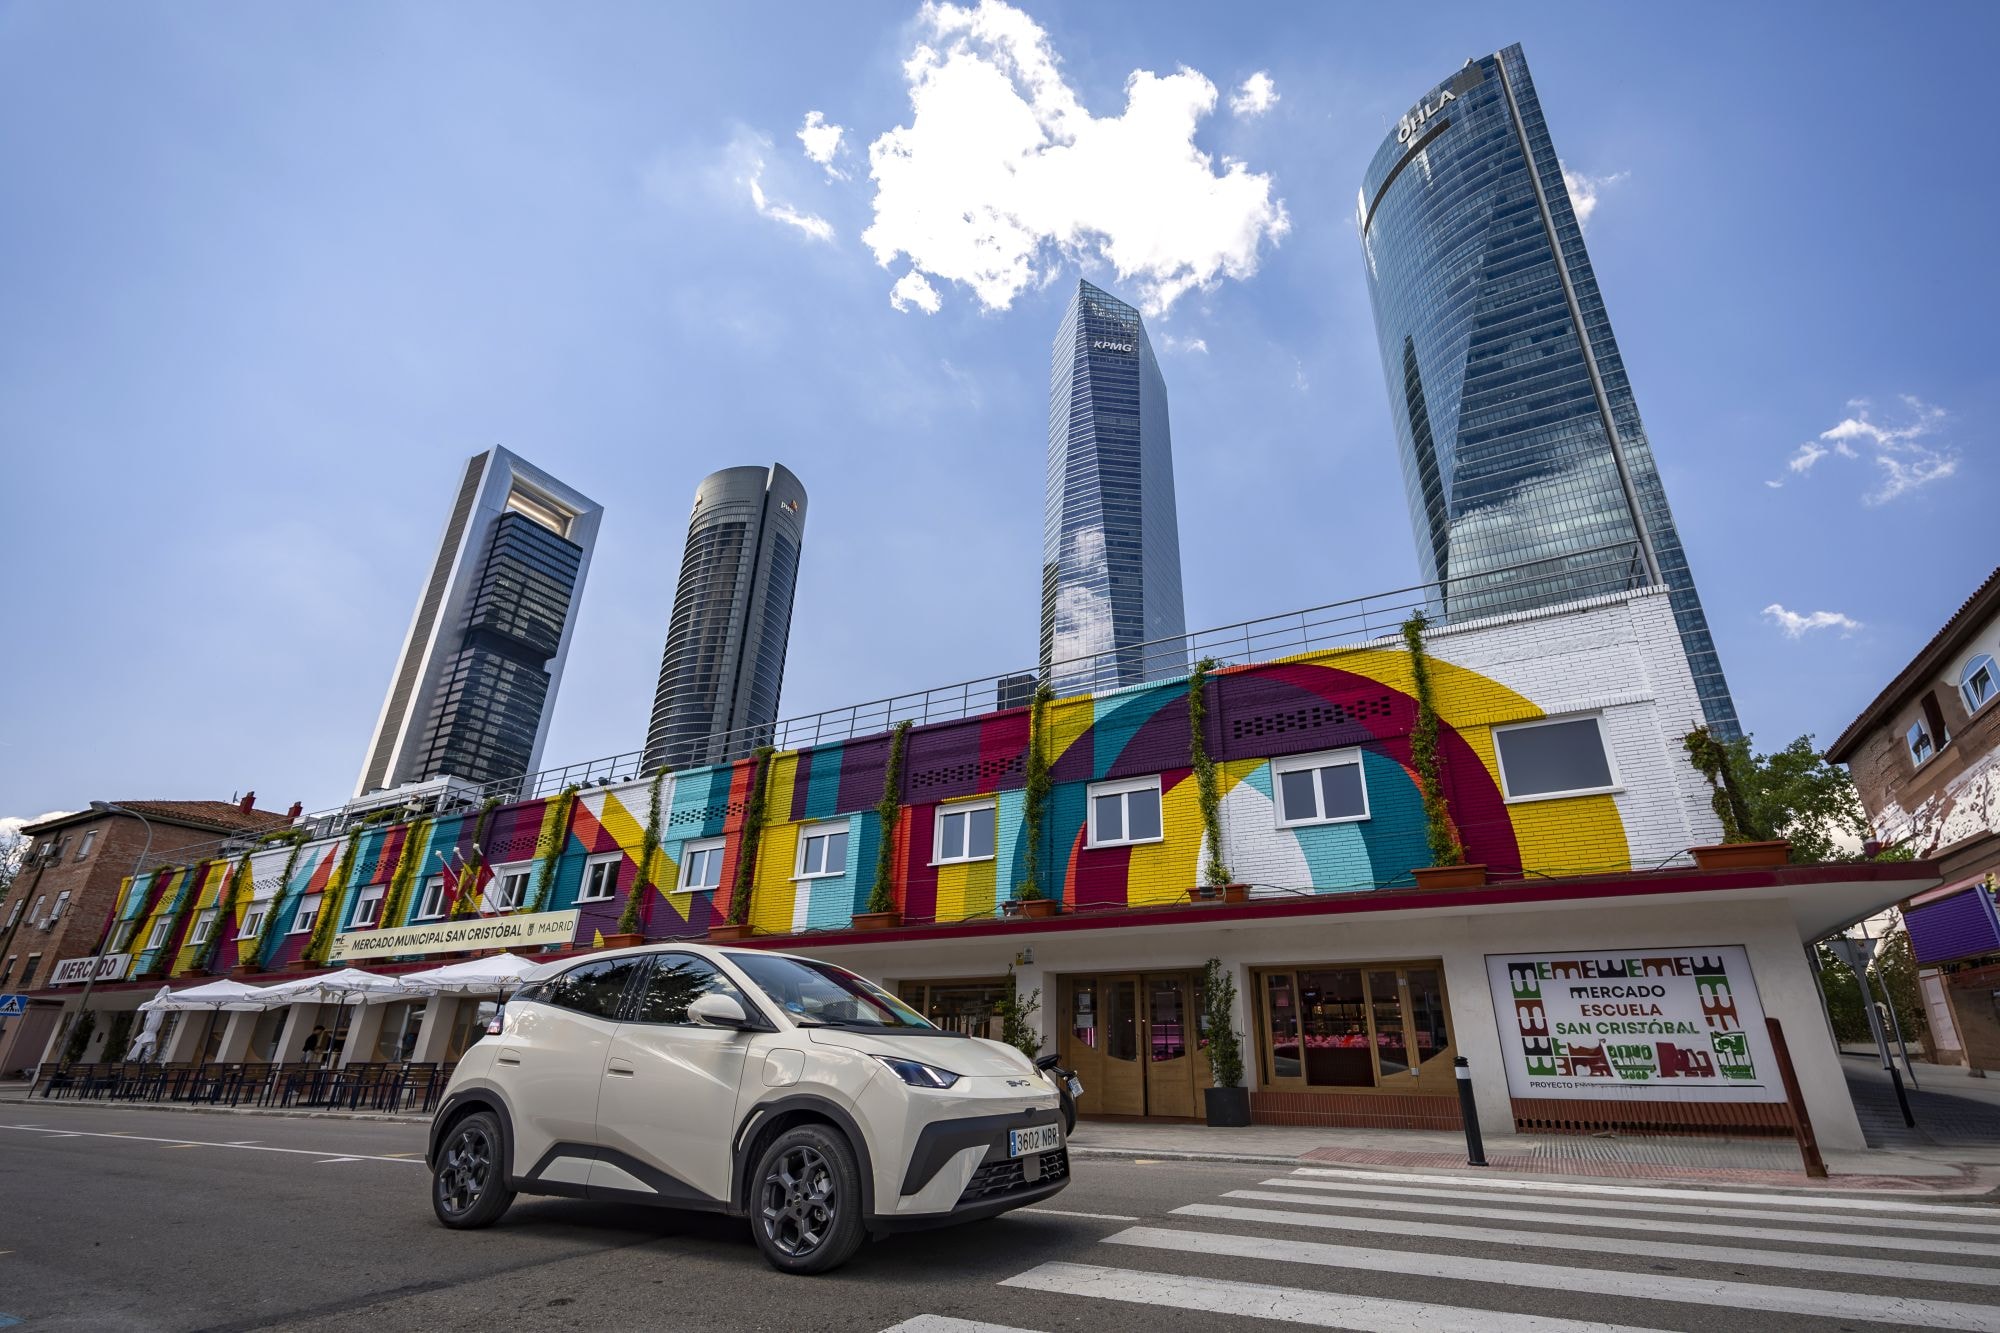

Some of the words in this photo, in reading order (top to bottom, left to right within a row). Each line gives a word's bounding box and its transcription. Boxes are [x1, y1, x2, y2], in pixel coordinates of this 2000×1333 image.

[1397, 89, 1456, 144] OHLA
[1093, 340, 1132, 352] KPMG
[351, 935, 395, 951] MERCADO
[394, 931, 445, 947] MUNICIPAL
[445, 929, 466, 943] SAN
[467, 922, 522, 941] CRISTÓBAL
[538, 920, 574, 934] MADRID
[1580, 1003, 1663, 1017] ESCUELA
[1555, 1022, 1592, 1035] SAN
[1595, 1018, 1700, 1035] CRISTÓBAL
[1529, 1081, 1573, 1089] PROYECTO
[1017, 1131, 1040, 1152] 3602
[1042, 1127, 1057, 1147] NBR
